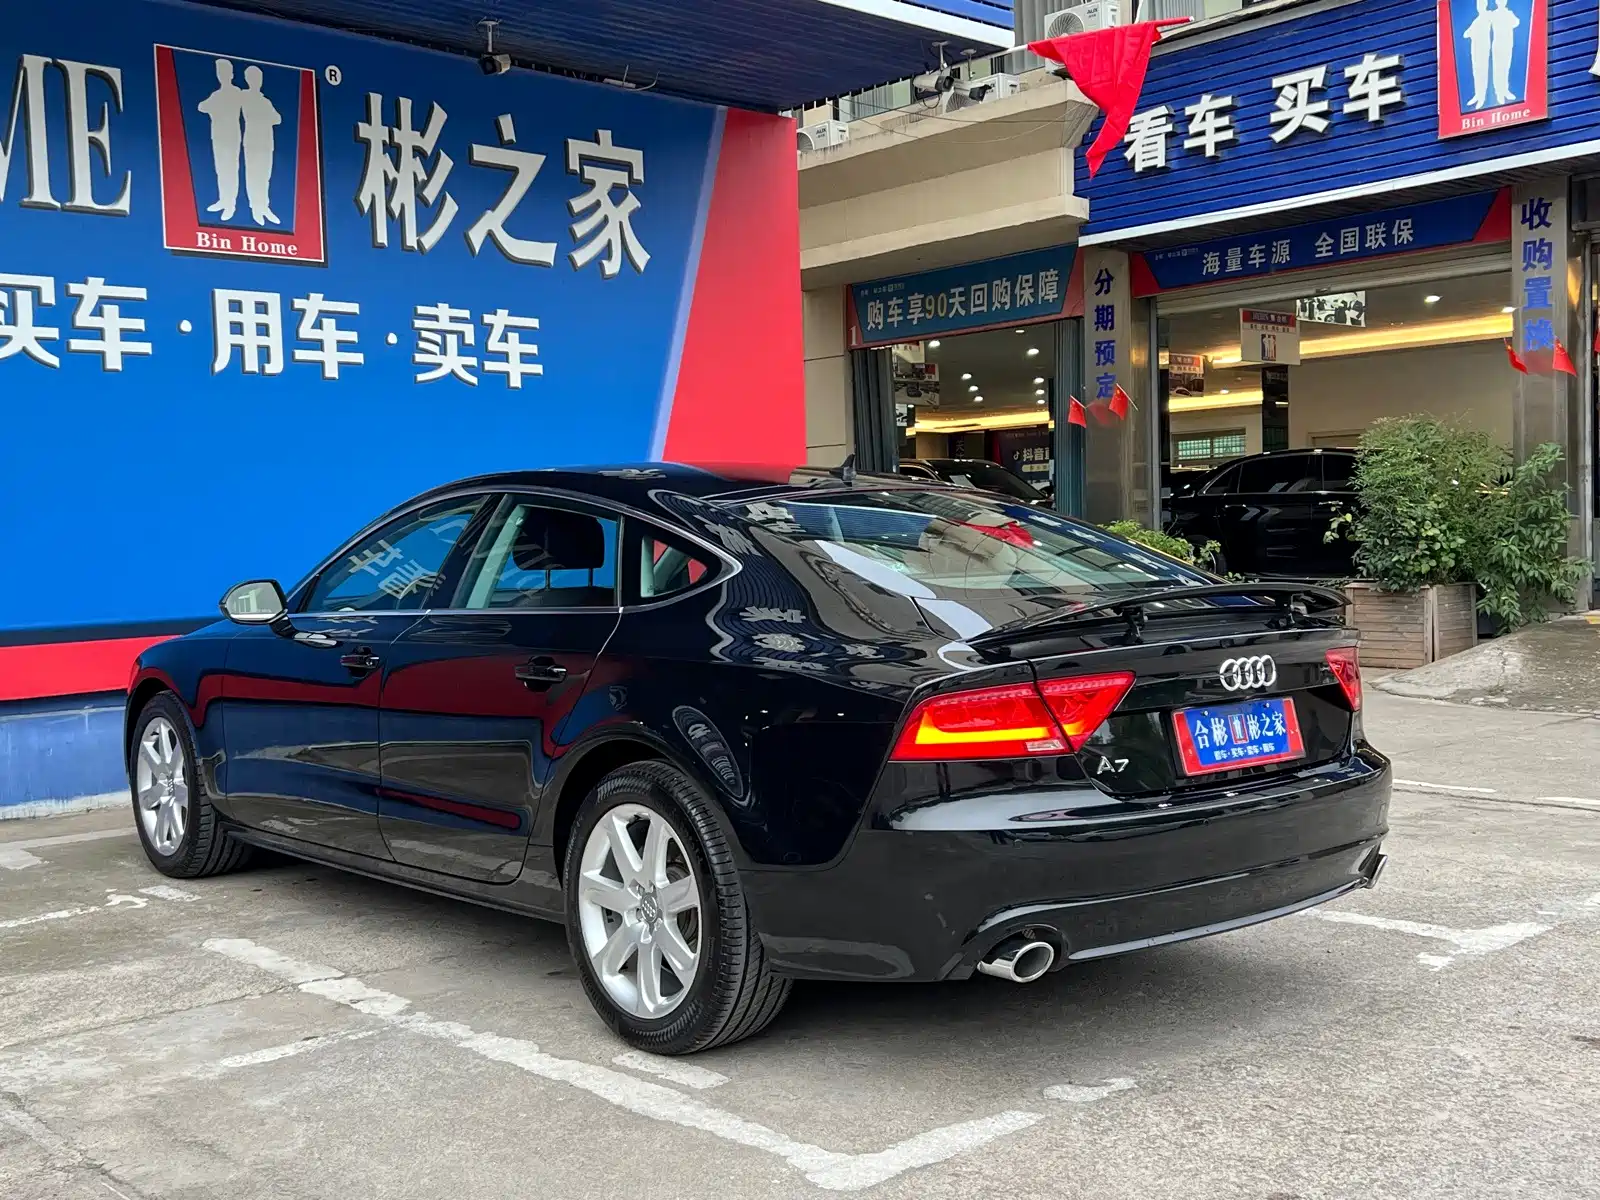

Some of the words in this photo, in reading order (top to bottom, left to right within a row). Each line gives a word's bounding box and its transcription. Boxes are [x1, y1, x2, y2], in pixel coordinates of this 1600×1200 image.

[1124, 94, 1237, 173] 看车
[1270, 54, 1403, 143] 买车
[1461, 115, 1486, 131] Bin
[1491, 106, 1531, 126] Home
[355, 92, 651, 277] 彬之家
[196, 231, 232, 250] Bin
[241, 236, 298, 256] Home
[1202, 238, 1291, 276] 海量车源
[1315, 218, 1414, 258] 全国联保
[867, 268, 1060, 332] 购车享90天回购保障
[1521, 197, 1555, 352] 收购置换
[1093, 267, 1117, 400] 分期预定
[1247, 711, 1286, 741] 彬之家
[1097, 756, 1130, 775] A7
